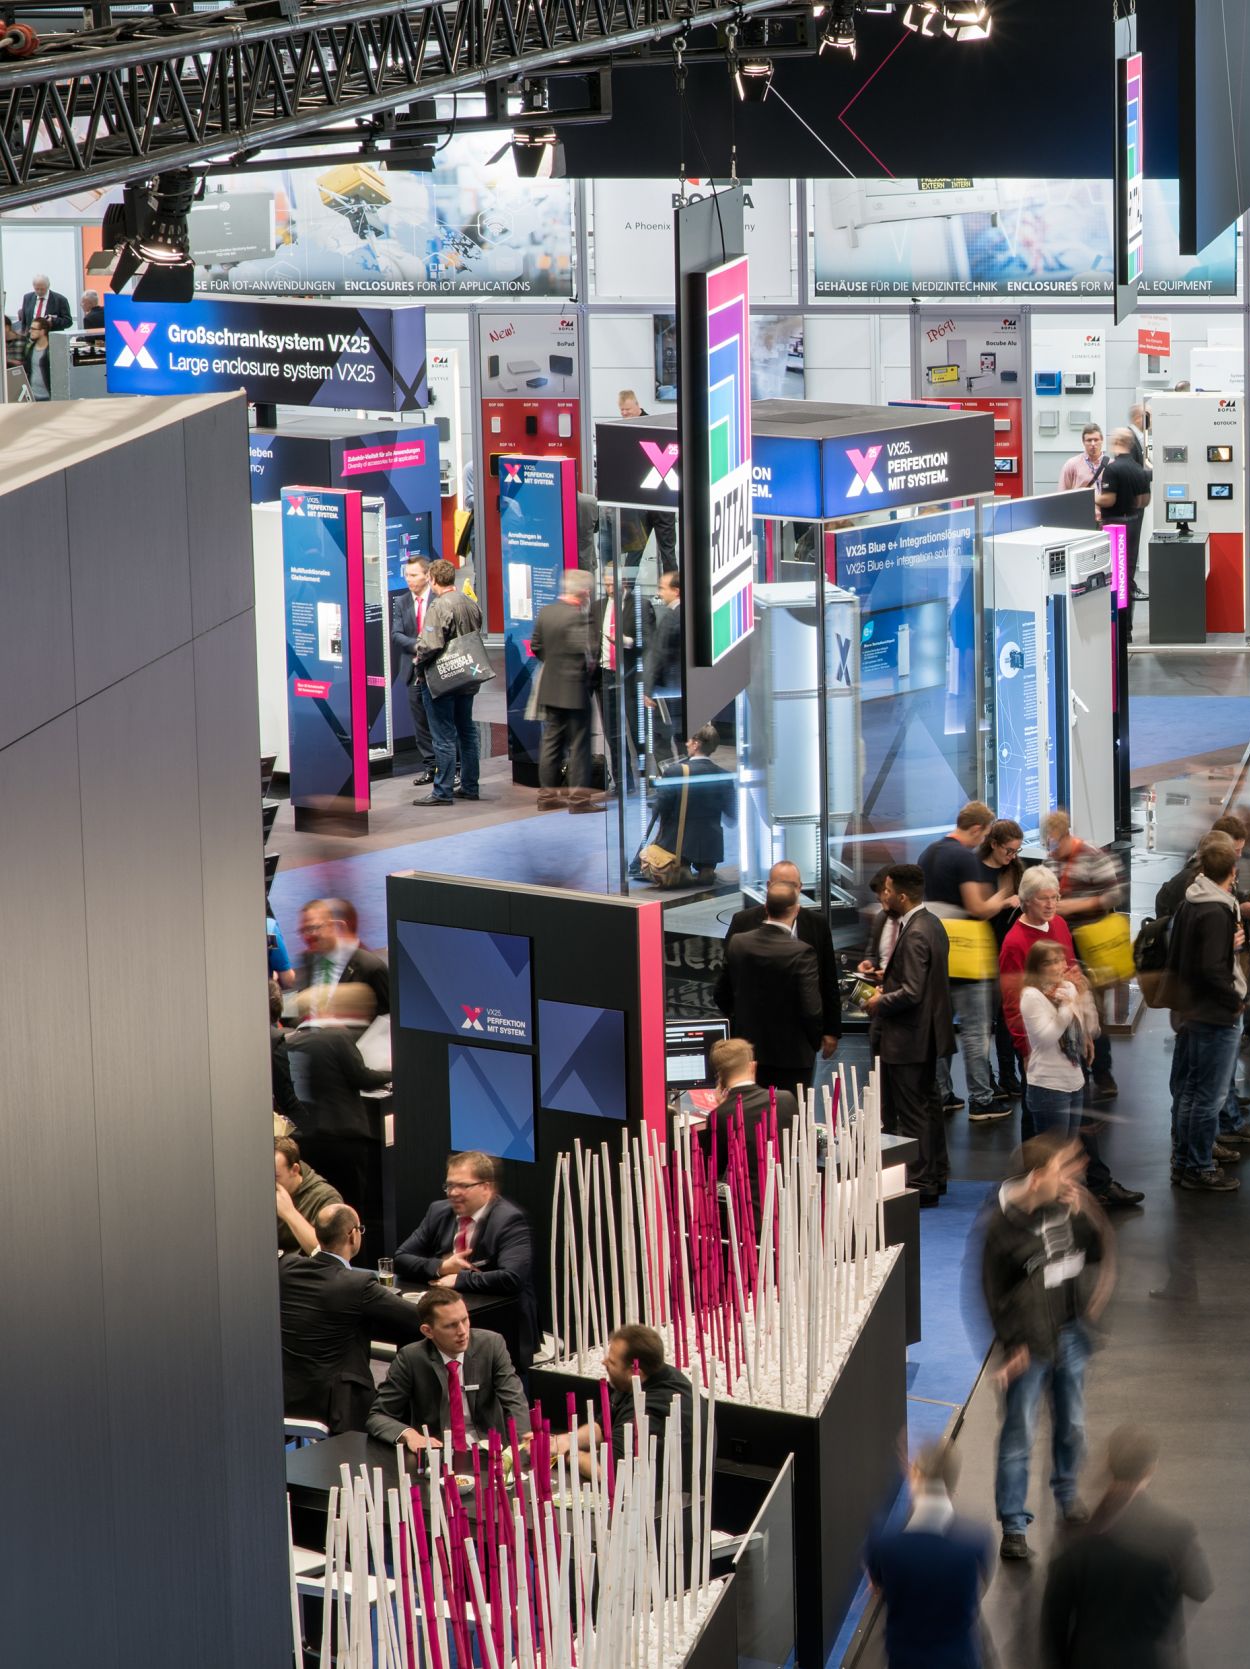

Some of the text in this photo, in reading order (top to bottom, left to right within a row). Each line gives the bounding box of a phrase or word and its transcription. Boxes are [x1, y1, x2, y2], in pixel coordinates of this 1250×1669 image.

[625, 222, 671, 230] A Phoenix
[210, 279, 229, 291] FÜR
[232, 280, 336, 291] IOT-ANWENDUNGEN
[344, 281, 531, 291] ENCLOSURES FOR IOT APPLICATIONS
[816, 280, 998, 292] GEHÄUSE FÜR DIE MEDIZINTECHNIK
[1007, 281, 1078, 291] ENCLOSURES
[1081, 281, 1101, 291] FOR
[1153, 280, 1213, 291] EQUIPMENT
[168, 324, 370, 354] Großschranksystem VX25
[169, 352, 376, 382] Large enclosure system VX25
[249, 447, 273, 459] leben
[887, 441, 913, 456] VX25.
[888, 452, 948, 474] PERFEKTION
[524, 471, 555, 479] PERFEKTION
[888, 470, 949, 491] MIT SYSTEM.
[307, 504, 339, 512] PERFEKTION
[712, 479, 752, 574] RITTAL
[845, 527, 971, 558] VX25 Blue e+ Integrationslösung
[845, 546, 962, 575] VX25 Blue e+ integration solution
[487, 1016, 526, 1029] PERFEKTION
[487, 1025, 527, 1037] MIT SYSTEM.
